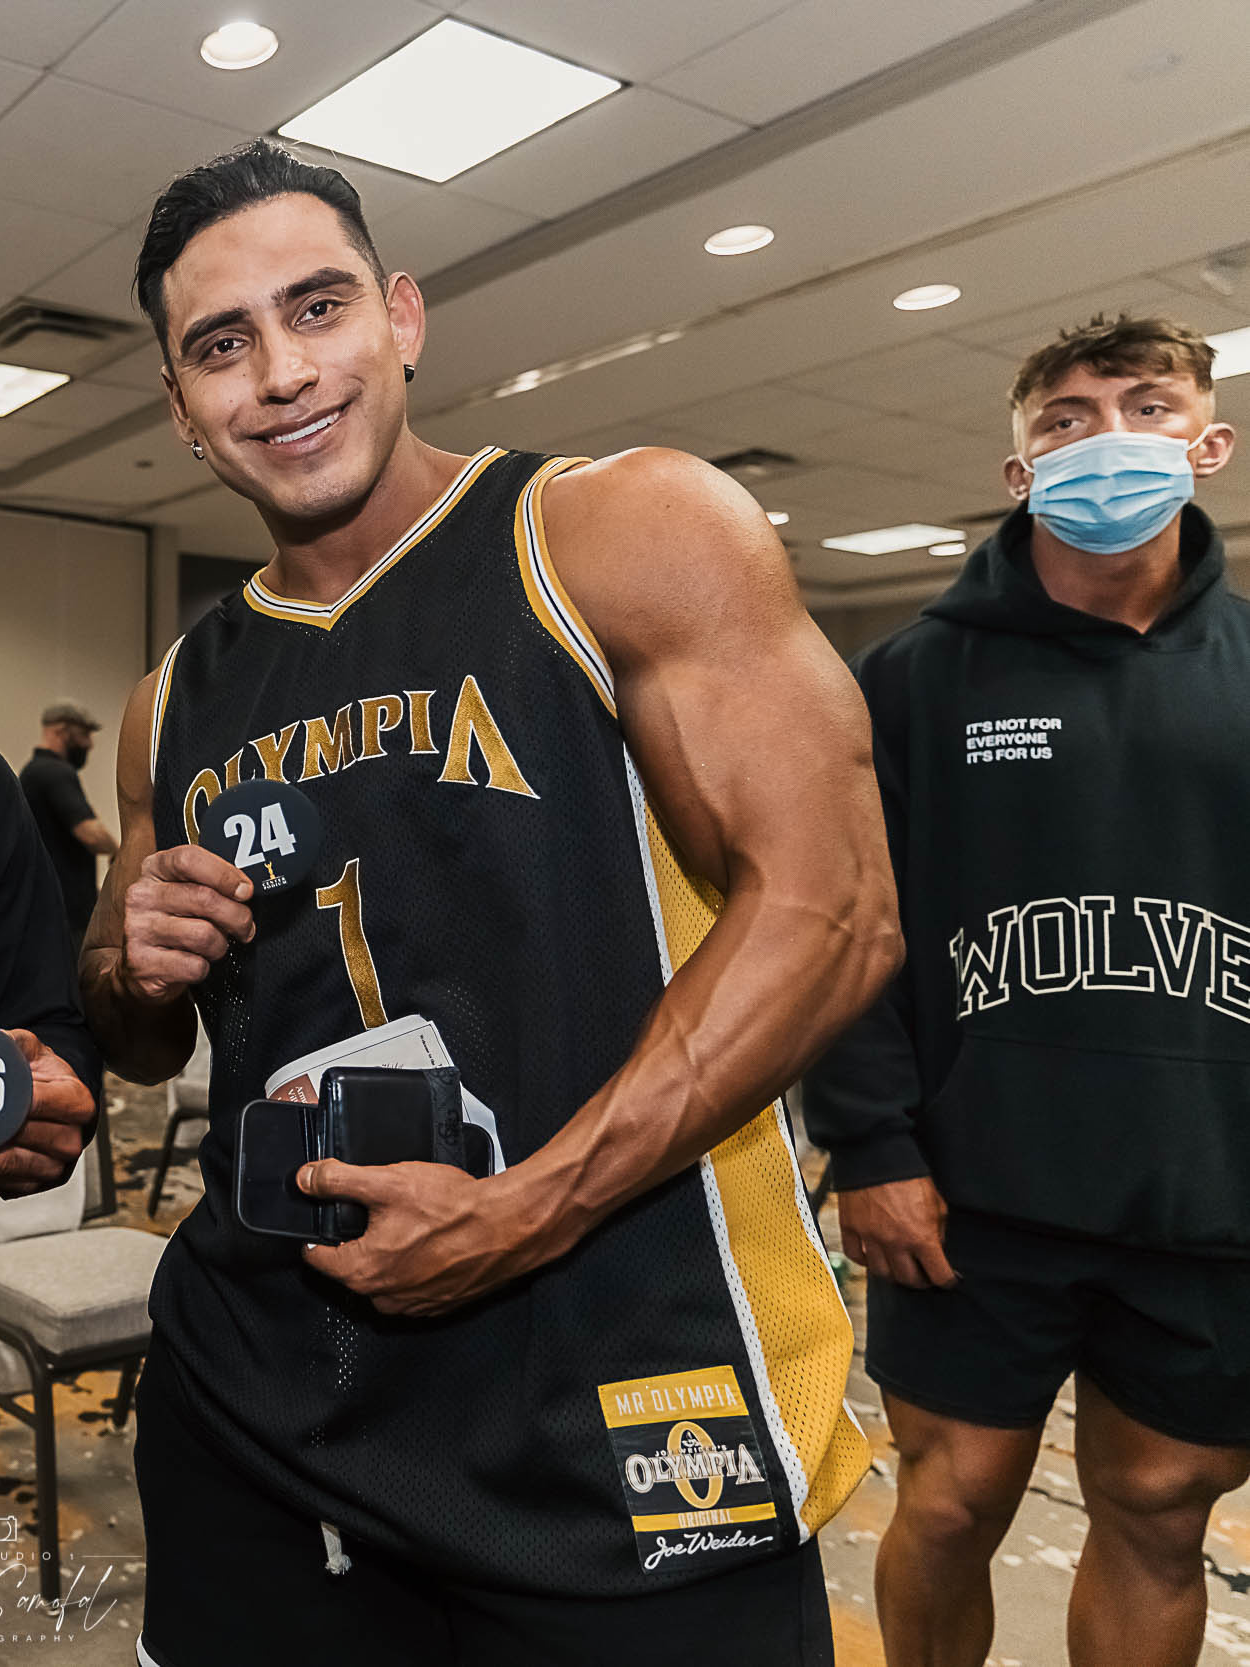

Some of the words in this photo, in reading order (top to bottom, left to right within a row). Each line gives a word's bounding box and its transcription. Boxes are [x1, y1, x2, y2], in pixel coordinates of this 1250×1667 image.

[966, 721, 993, 735] IT'S
[995, 718, 1028, 731] NOT
[1030, 718, 1062, 730] FOR
[966, 732, 1048, 750] EVERYONE
[966, 750, 993, 764] IT'S
[995, 748, 1028, 761] FOR
[1031, 747, 1053, 759] US
[223, 802, 297, 869] 24
[316, 858, 388, 1030] 1
[950, 896, 1250, 1023] WOLVE
[615, 1391, 646, 1417] MR
[651, 1383, 738, 1413] OLYMPIA
[625, 1443, 766, 1494] OLYMPIA
[677, 1508, 734, 1529] ORIGINAL
[644, 1536, 687, 1570] Joe
[684, 1530, 774, 1555] Weider
